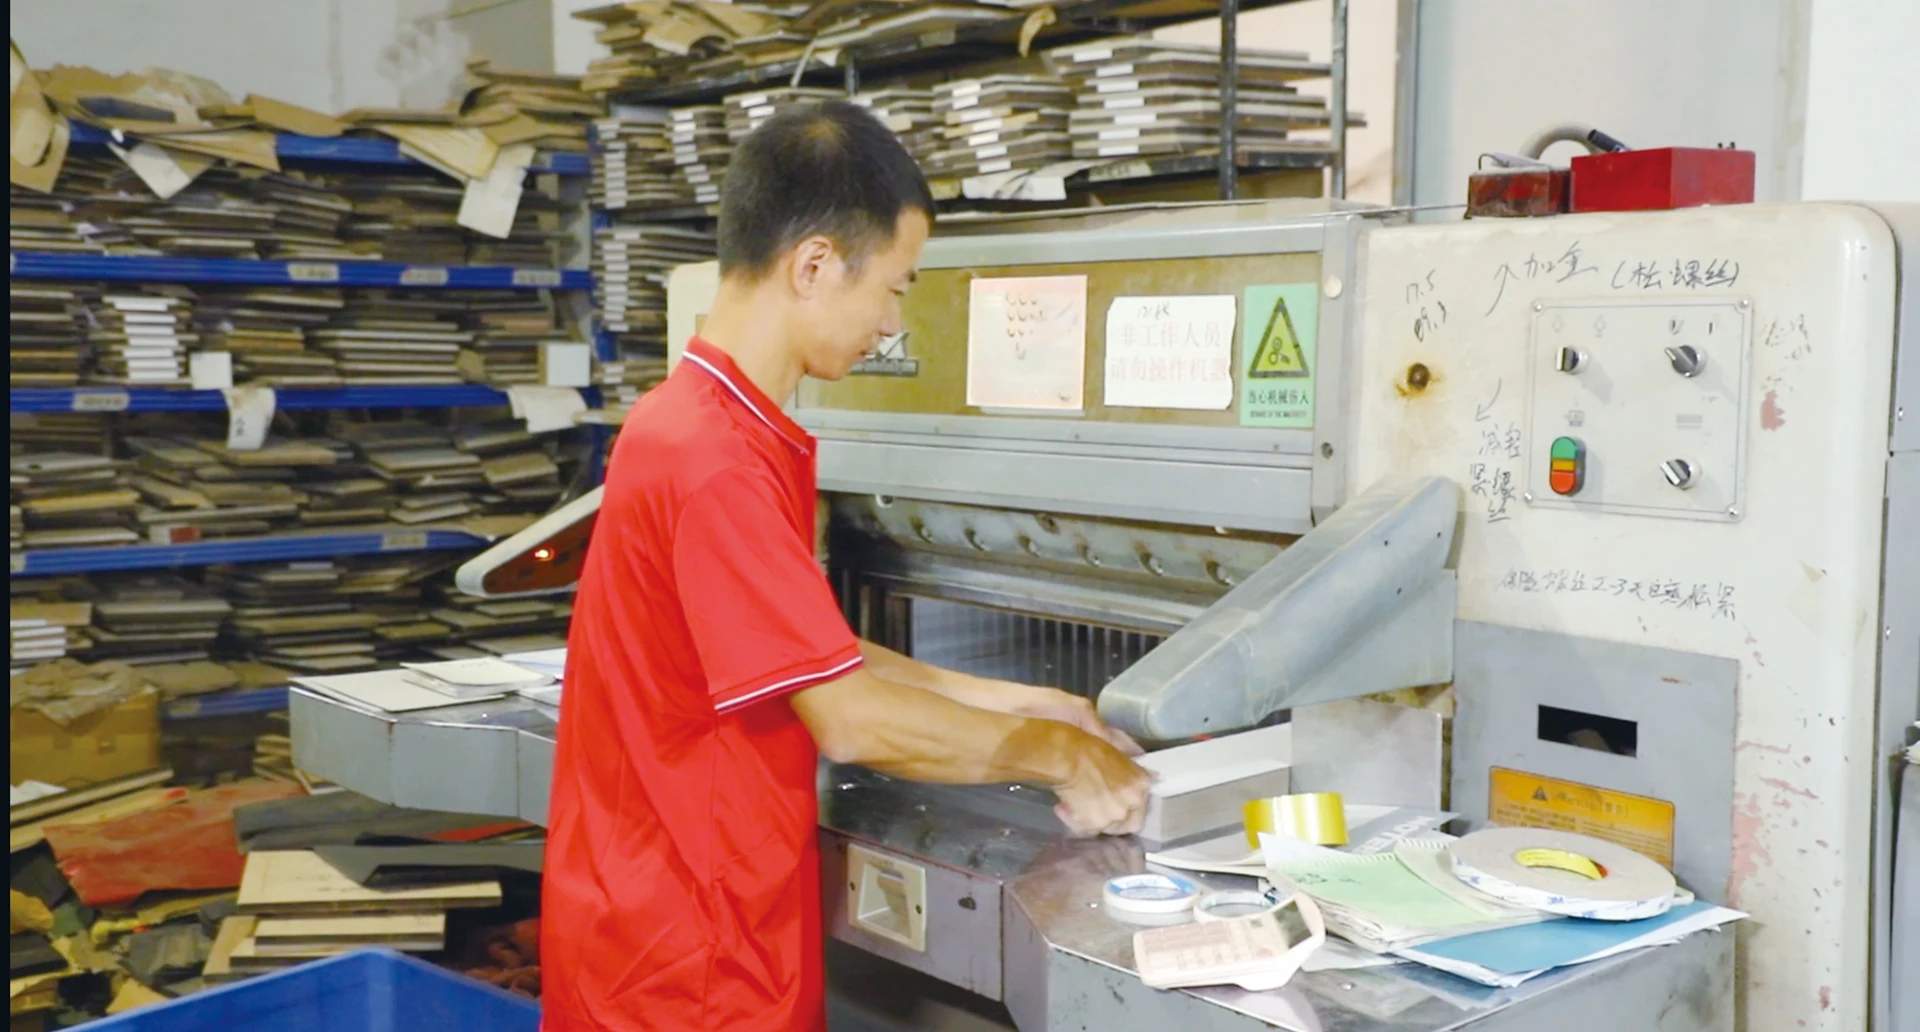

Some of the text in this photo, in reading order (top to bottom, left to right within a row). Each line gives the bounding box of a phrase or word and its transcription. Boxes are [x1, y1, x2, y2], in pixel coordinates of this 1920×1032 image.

[1119, 322, 1221, 348] 非工作人员
[1110, 356, 1228, 382] 请勿操作机器
